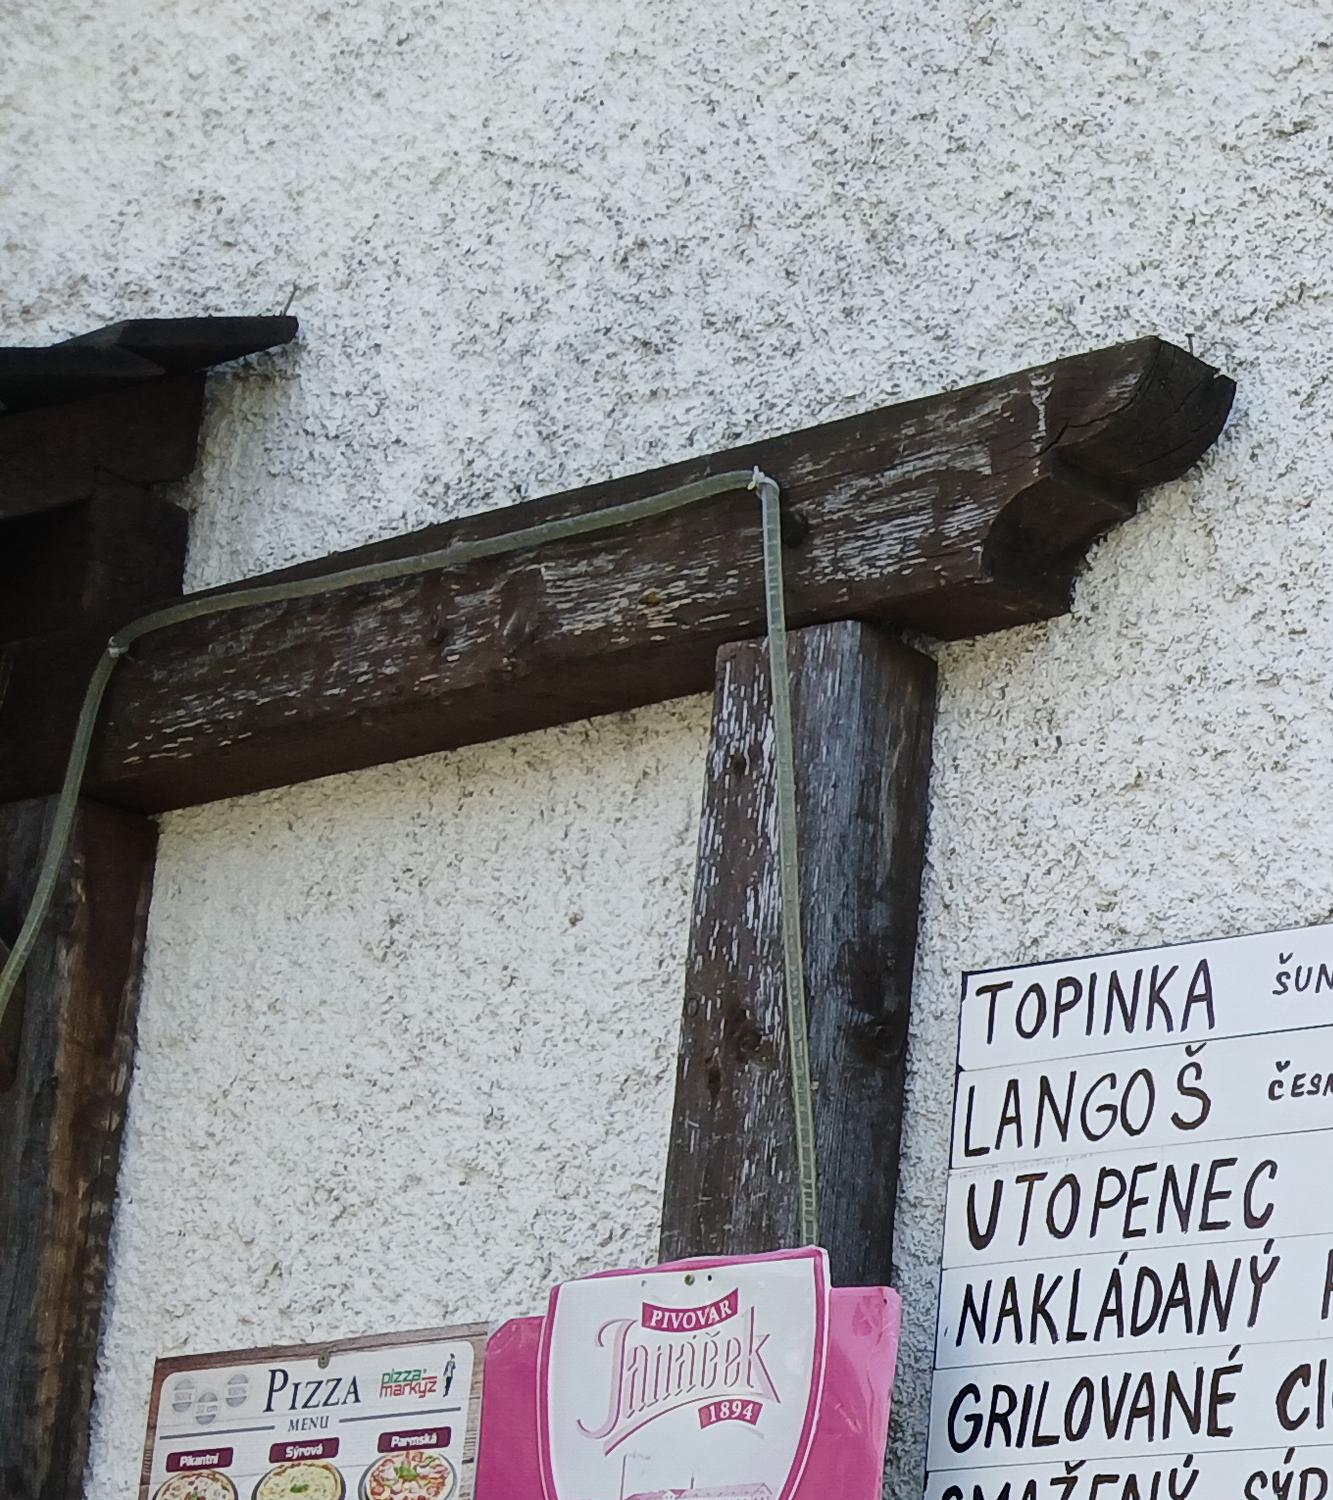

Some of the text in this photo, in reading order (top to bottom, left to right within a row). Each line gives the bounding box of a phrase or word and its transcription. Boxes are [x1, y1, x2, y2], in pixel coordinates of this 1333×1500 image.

[976, 959, 1215, 1044] TOPINKA
[963, 1042, 1212, 1158] LANGOŠ
[967, 1158, 1279, 1250] UTOPENEC
[650, 1300, 733, 1329] PIVOVAR
[955, 1238, 1281, 1347] NAKLÁDANÝ
[287, 1416, 330, 1433] MENU
[708, 1402, 753, 1423] 1894
[947, 1345, 1244, 1453] GRILOVANÉ
